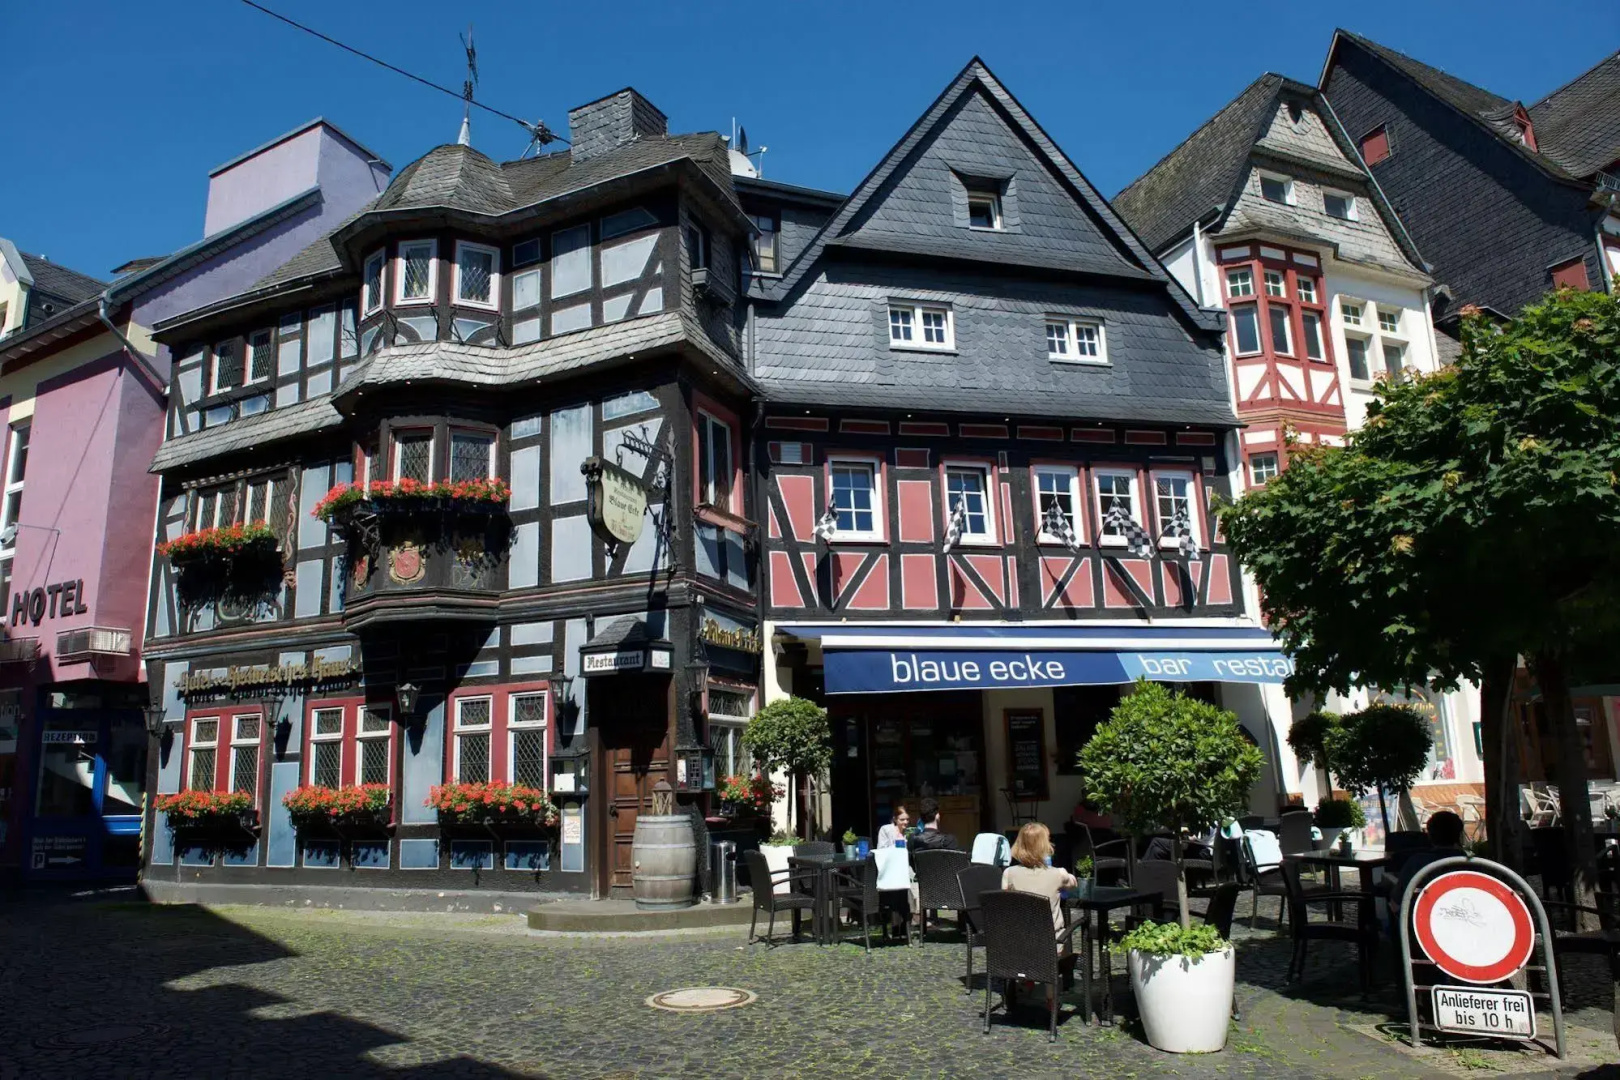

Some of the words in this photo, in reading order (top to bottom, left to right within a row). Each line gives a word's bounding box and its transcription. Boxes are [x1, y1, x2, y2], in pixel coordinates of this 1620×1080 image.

[11, 579, 88, 628] HOTEL
[587, 652, 641, 669] Restaurant
[892, 653, 981, 683] blaue
[990, 655, 1066, 681] ecke
[1138, 654, 1192, 676] bar
[1441, 992, 1499, 1011] Anlieferer
[1502, 997, 1525, 1012] frei
[1455, 1010, 1475, 1026] bis
[1482, 1012, 1499, 1028] 10
[1504, 1014, 1513, 1029] h
